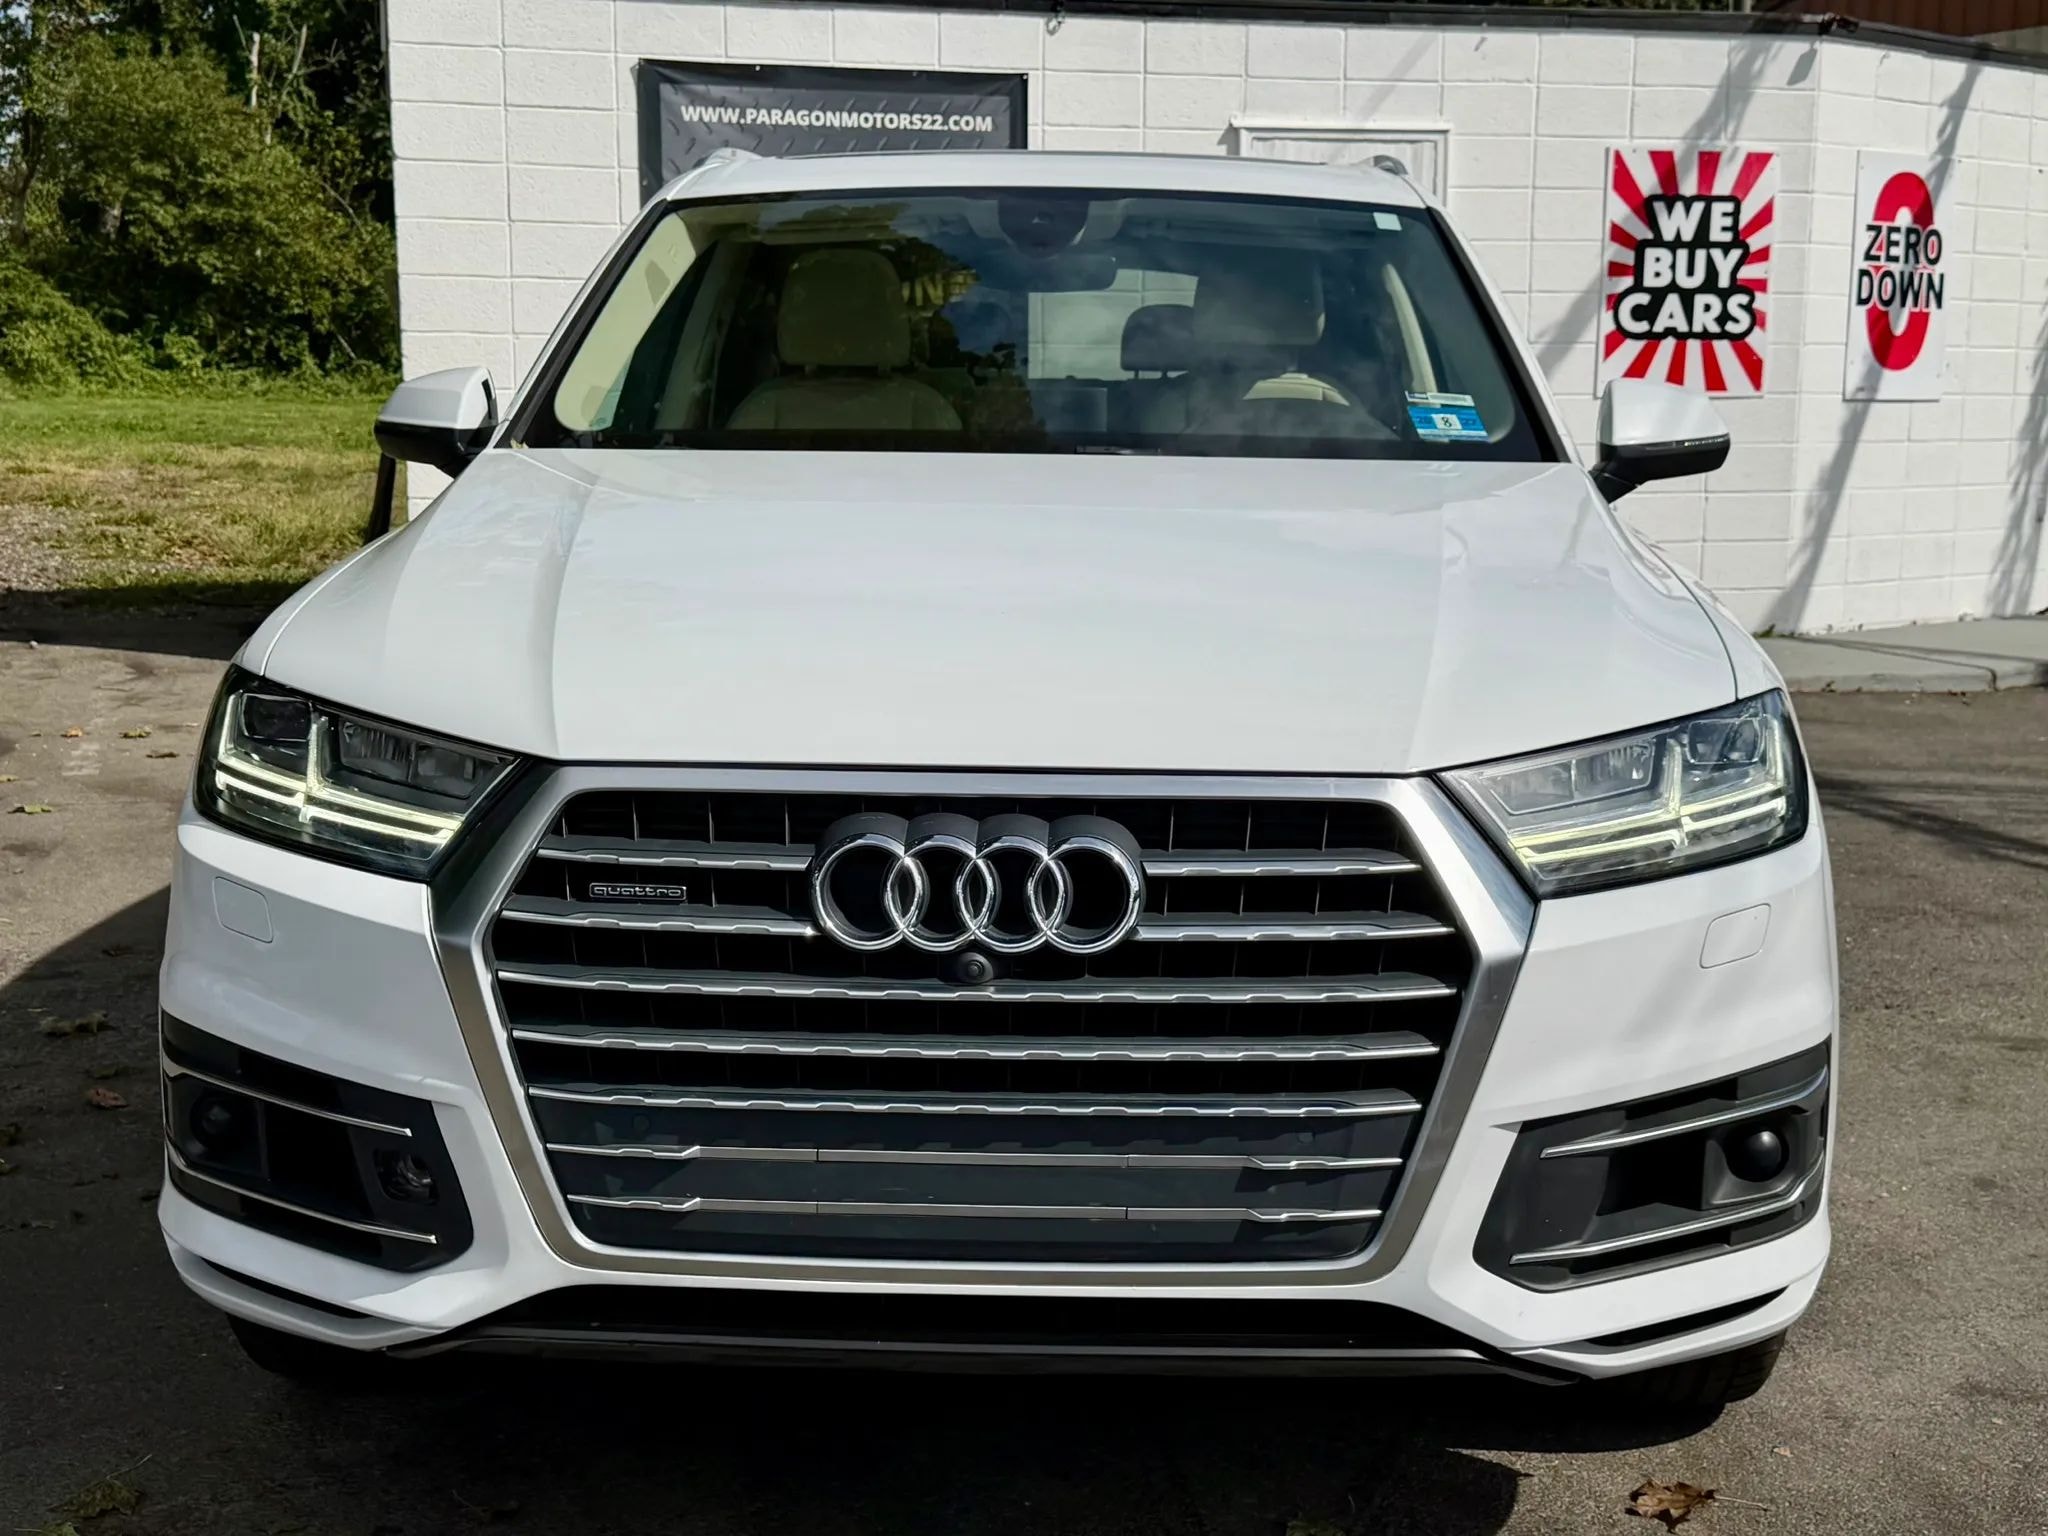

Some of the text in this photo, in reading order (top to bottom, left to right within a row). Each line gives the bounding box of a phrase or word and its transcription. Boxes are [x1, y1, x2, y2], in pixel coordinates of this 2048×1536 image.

[681, 105, 993, 132] WWW.PARAGONMOTORS22.COM
[1652, 201, 1735, 241] WE
[1863, 225, 1943, 265] ZERO
[1642, 247, 1742, 288] BUY
[1856, 269, 1944, 309] DOWN
[1618, 293, 1751, 334] CARS
[1441, 416, 1452, 428] 8
[594, 885, 681, 897] quattro
